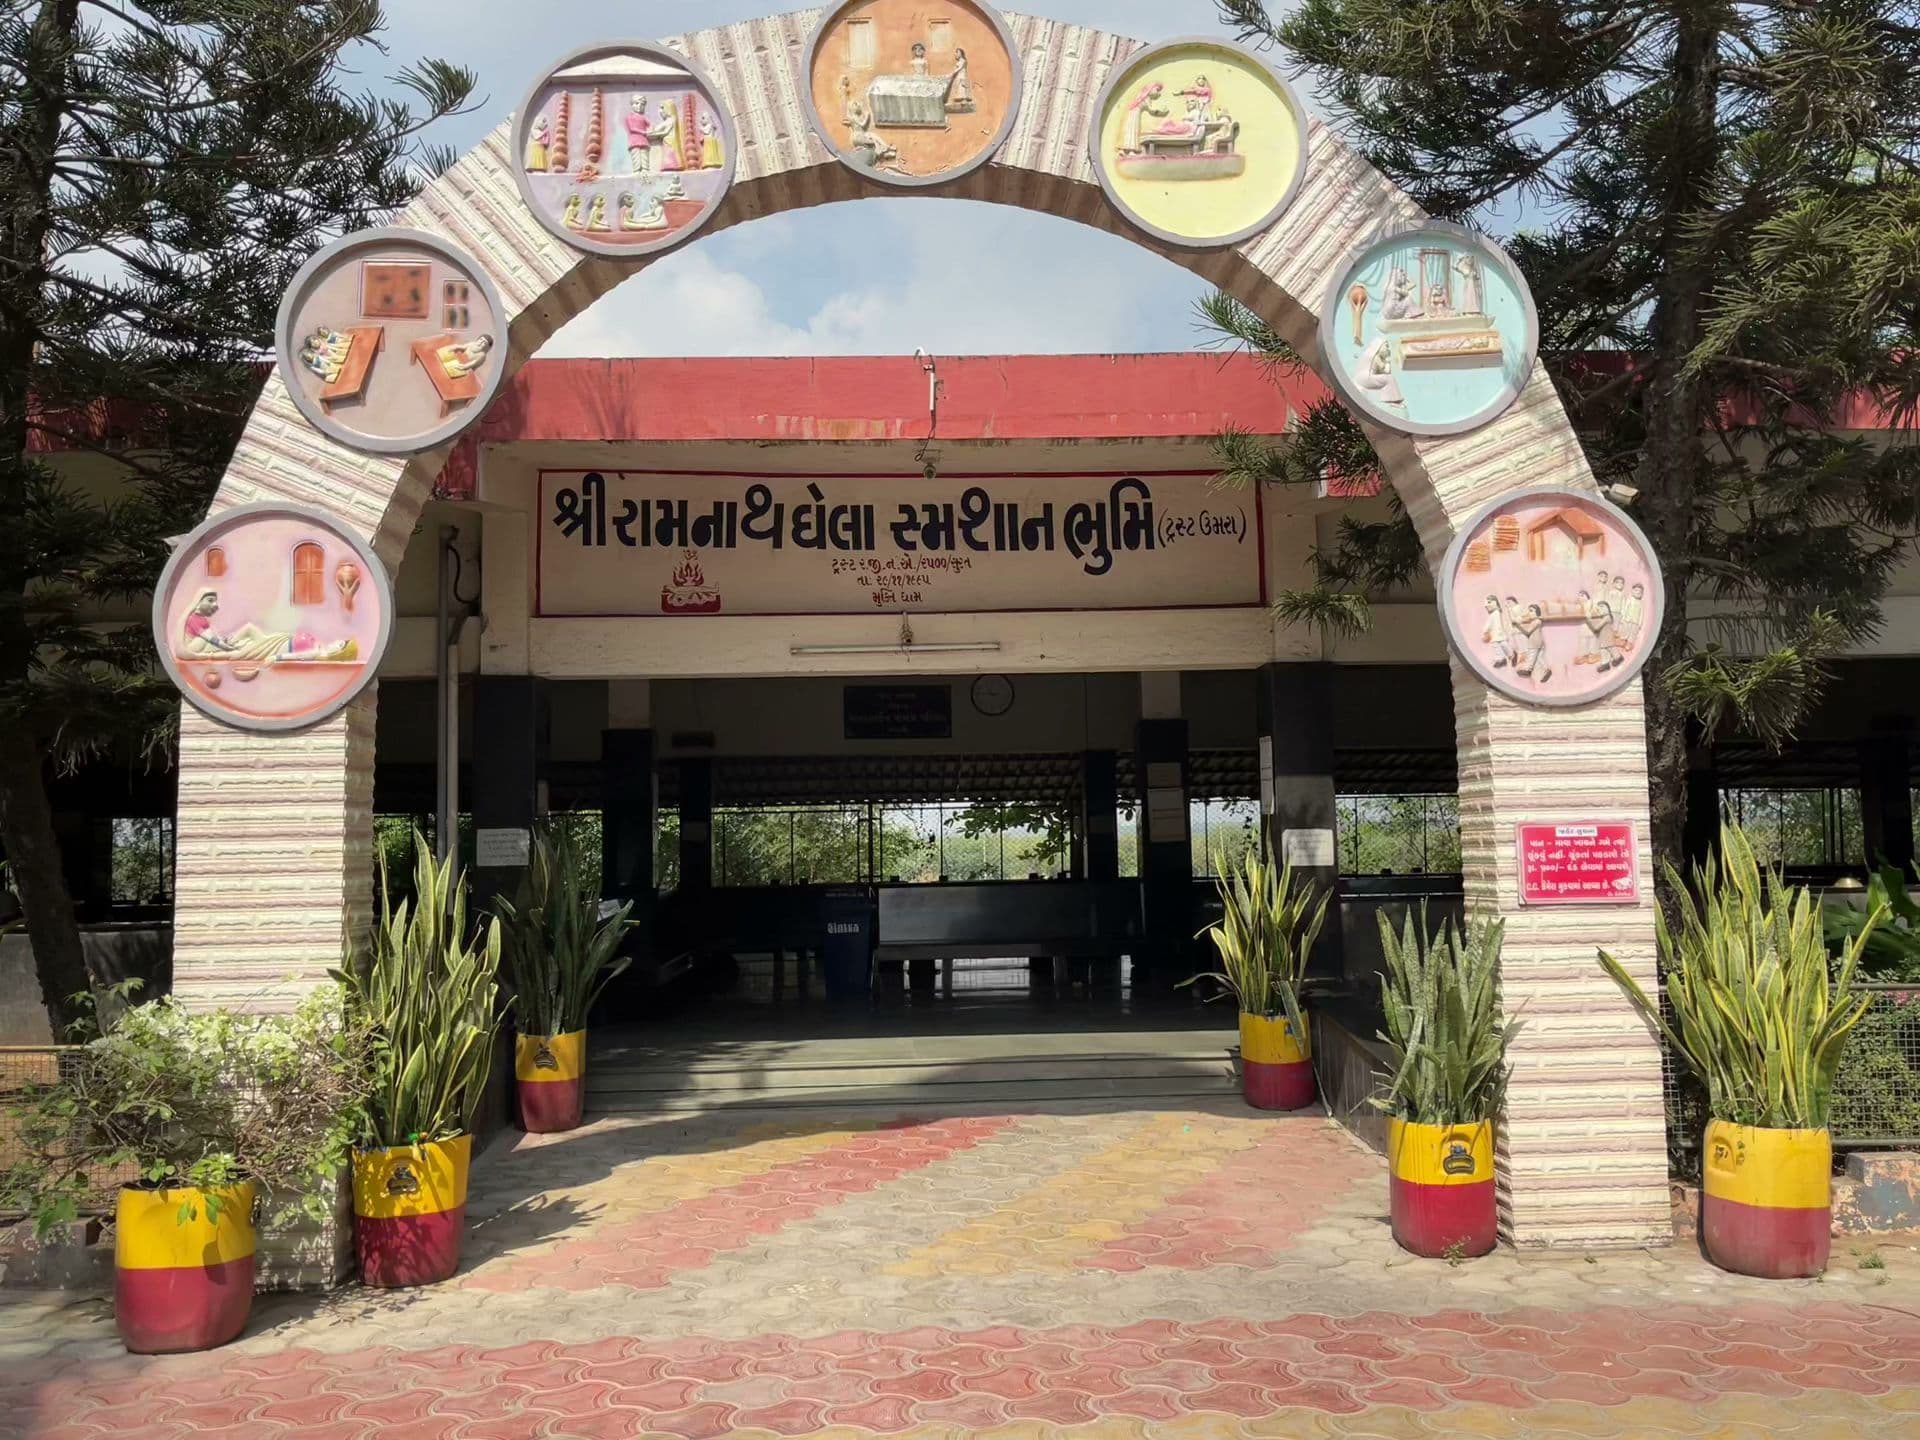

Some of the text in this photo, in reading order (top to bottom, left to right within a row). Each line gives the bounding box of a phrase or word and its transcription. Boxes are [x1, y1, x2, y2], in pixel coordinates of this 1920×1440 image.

[553, 472, 606, 546] શ્રી
[612, 484, 784, 549] રામનાથ
[792, 482, 876, 551] ઘેલા
[890, 487, 1055, 551] સ્મશાન
[1063, 478, 1155, 576] ભુમિ
